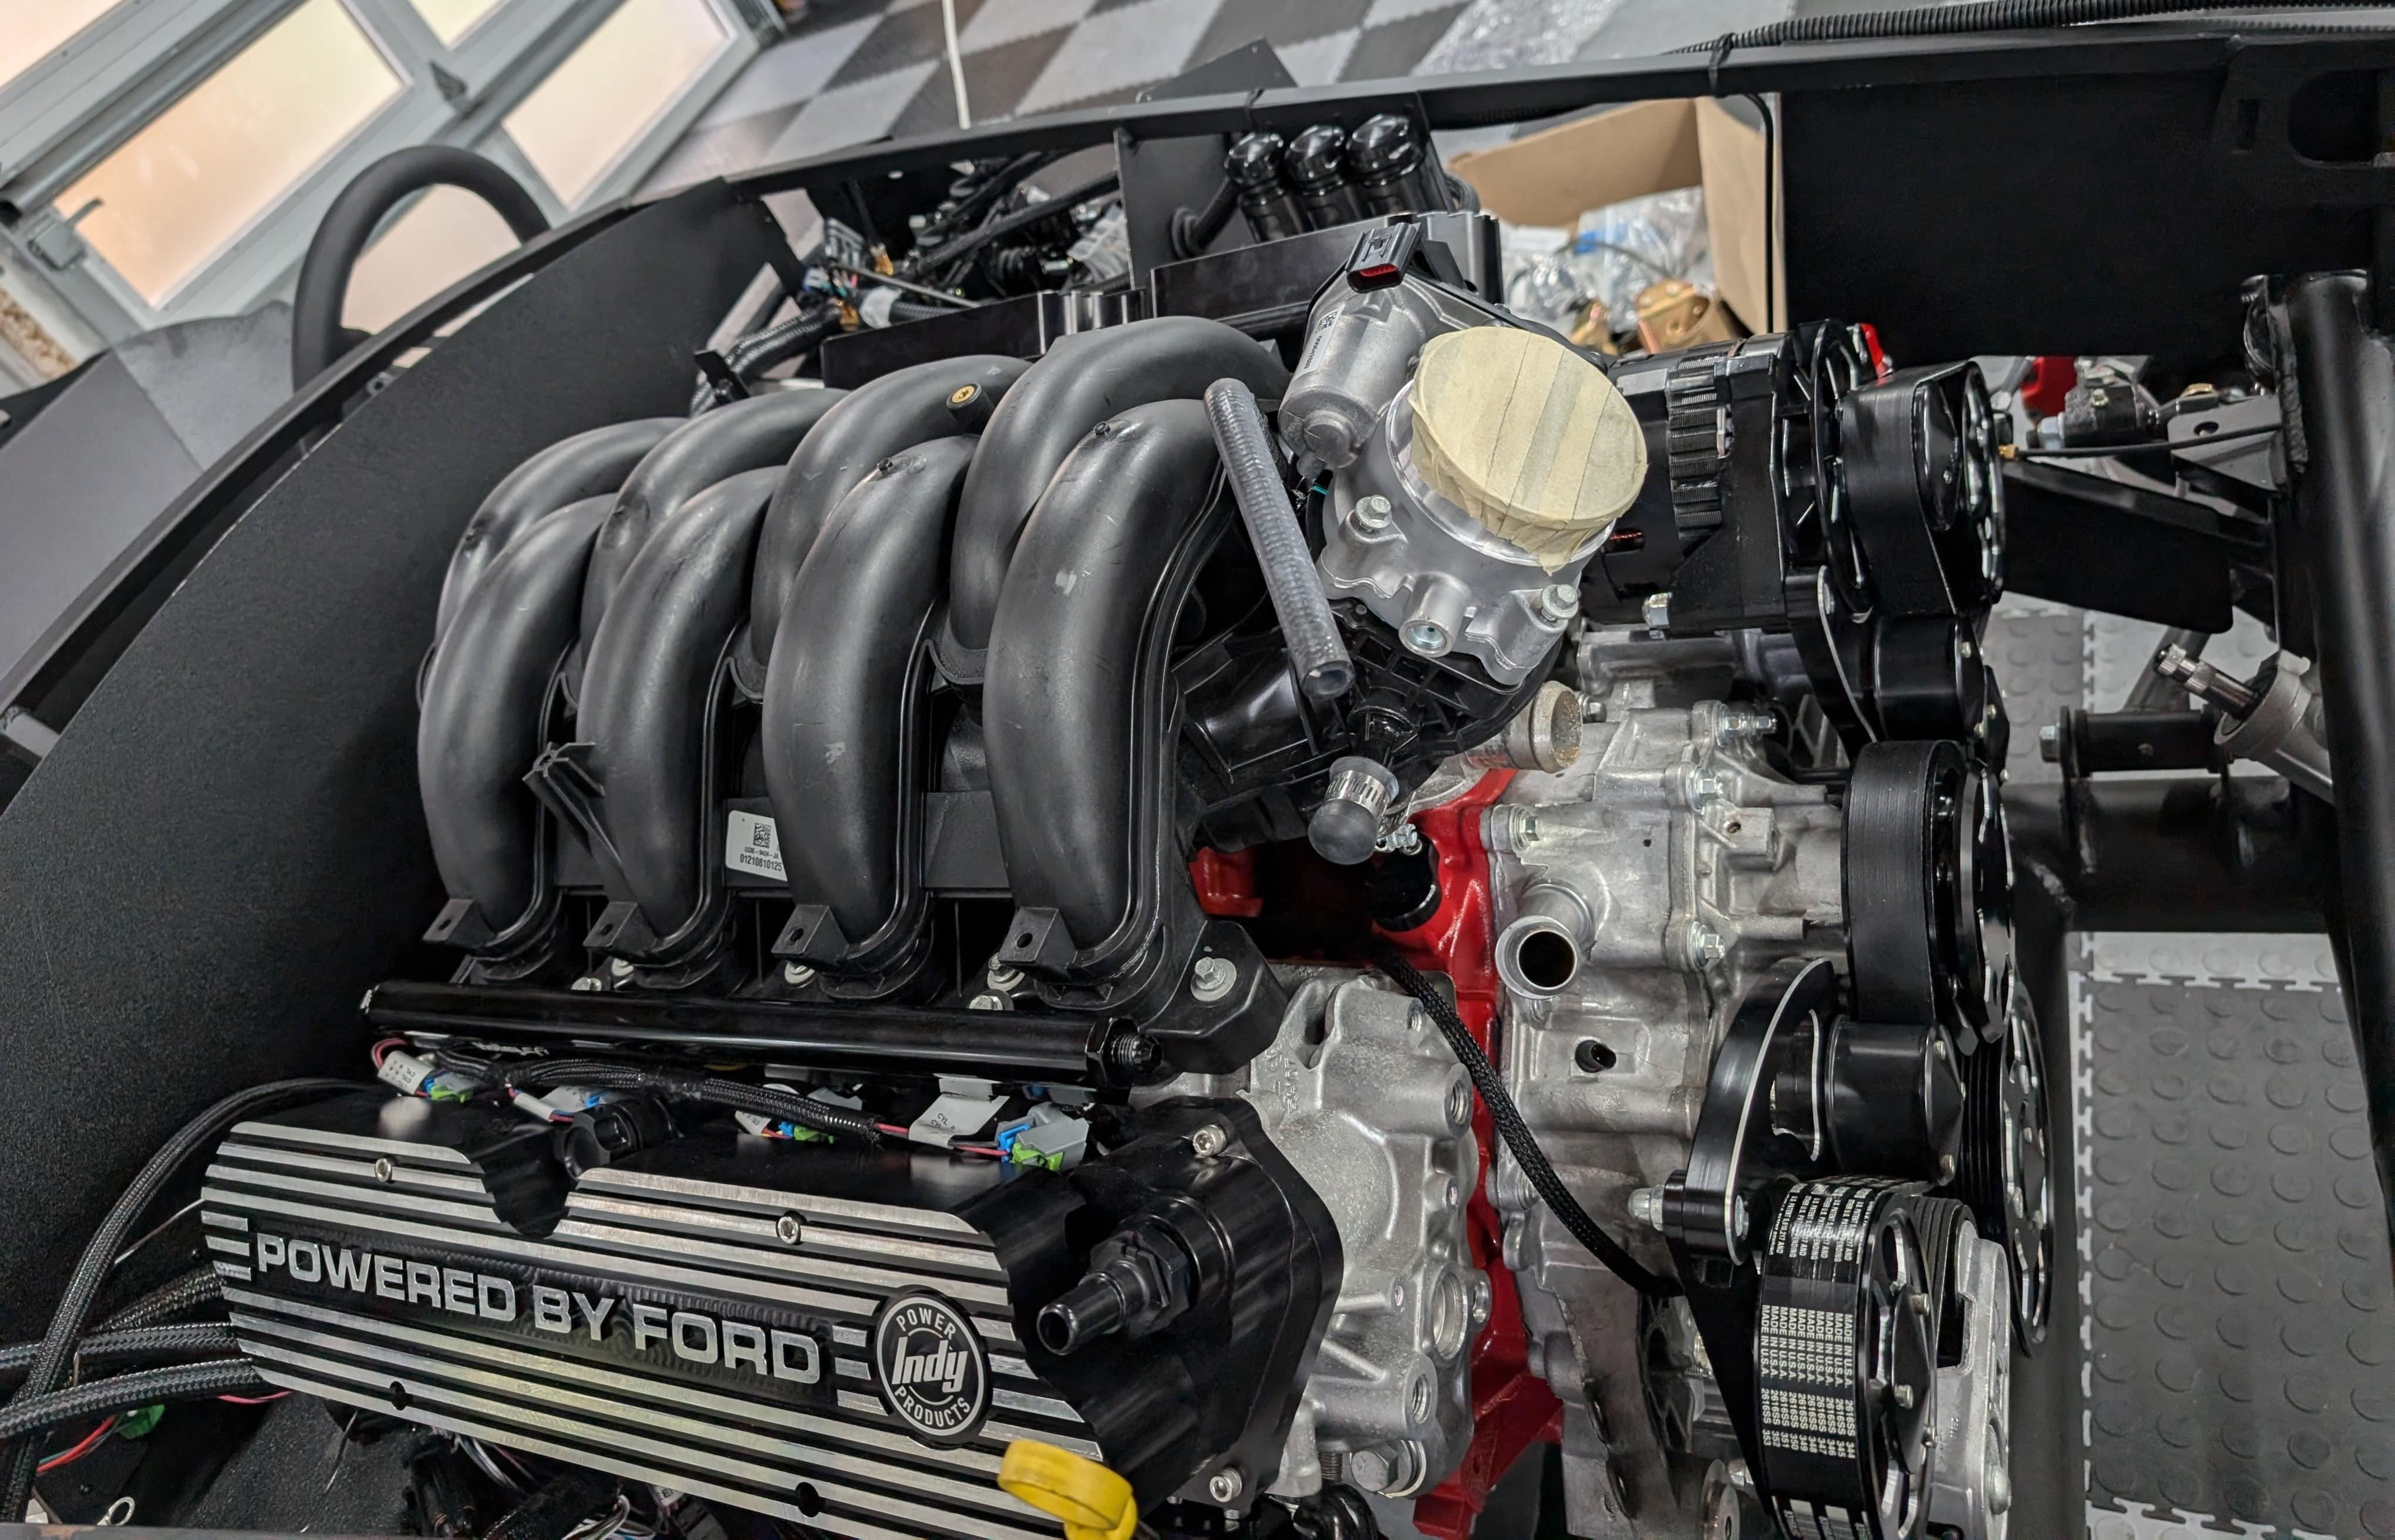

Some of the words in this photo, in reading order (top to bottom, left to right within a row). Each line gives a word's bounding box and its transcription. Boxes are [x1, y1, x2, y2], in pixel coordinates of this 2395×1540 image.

[740, 854, 782, 871] 01210810125
[938, 1113, 949, 1125] CYL
[1789, 1234, 1799, 1258] ENDING
[1799, 1244, 1808, 1256] AND
[1821, 1246, 1830, 1258] AND
[1834, 1238, 1844, 1262] ENDING
[1844, 1248, 1853, 1261] AND
[257, 1232, 516, 1322] POWERED
[533, 1284, 615, 1342] BY
[633, 1303, 820, 1384] FORD
[1761, 1305, 1770, 1333] MADE
[1770, 1306, 1779, 1334] MADE
[1780, 1307, 1788, 1335] MADE
[1789, 1308, 1798, 1336] MADE
[896, 1307, 956, 1340] POWER
[1798, 1309, 1807, 1337] MADE
[1807, 1310, 1816, 1339] MADE
[1817, 1311, 1825, 1340] MADE
[1826, 1312, 1834, 1341] MADE
[1835, 1313, 1844, 1342] MADE
[1844, 1314, 1853, 1343] MADE
[1761, 1336, 1770, 1346] IN
[1770, 1337, 1779, 1347] IN
[1780, 1338, 1788, 1348] IN
[1789, 1339, 1798, 1349] IN
[1798, 1340, 1807, 1350] IN
[1807, 1341, 1816, 1351] IN
[1817, 1342, 1825, 1352] IN
[1826, 1343, 1834, 1353] IN
[1835, 1344, 1844, 1354] IN
[1844, 1346, 1853, 1356] IN
[892, 1336, 968, 1393] Indy
[1761, 1348, 1770, 1377] U.S.A.
[1770, 1349, 1779, 1378] U.S.A.
[1780, 1350, 1788, 1379] U.S.A.
[1789, 1352, 1798, 1380] U.S.A.
[1798, 1353, 1807, 1381] U.S.A.
[1807, 1354, 1816, 1383] U.S.A.
[1817, 1355, 1825, 1384] U.S.A.
[1826, 1356, 1834, 1386] U.S.A.
[1835, 1357, 1844, 1387] U.S.A.
[1844, 1359, 1853, 1388] U.S.A.
[895, 1385, 970, 1427] PRODUCTS
[1761, 1389, 1770, 1424] 2616SS
[1770, 1390, 1780, 1425] 2616SS
[1780, 1391, 1789, 1426] 2616SS
[1789, 1392, 1798, 1428] 2616SS
[1798, 1393, 1808, 1429] 2616SS
[1807, 1395, 1817, 1431] 2616SS
[1817, 1396, 1827, 1432] 2616SS
[1826, 1397, 1836, 1433] 2616SS
[1835, 1399, 1845, 1435] 2616SS
[1845, 1400, 1855, 1436] 2616SS
[1762, 1430, 1770, 1445] 353
[1771, 1431, 1780, 1447] 352
[1781, 1432, 1790, 1448] 351
[1790, 1434, 1799, 1450] 350
[1799, 1435, 1808, 1451] 349
[1808, 1436, 1818, 1453] 348
[1818, 1438, 1827, 1454] 347
[1827, 1439, 1837, 1455] 346
[1836, 1440, 1846, 1457] 345
[1845, 1442, 1855, 1458] 344
